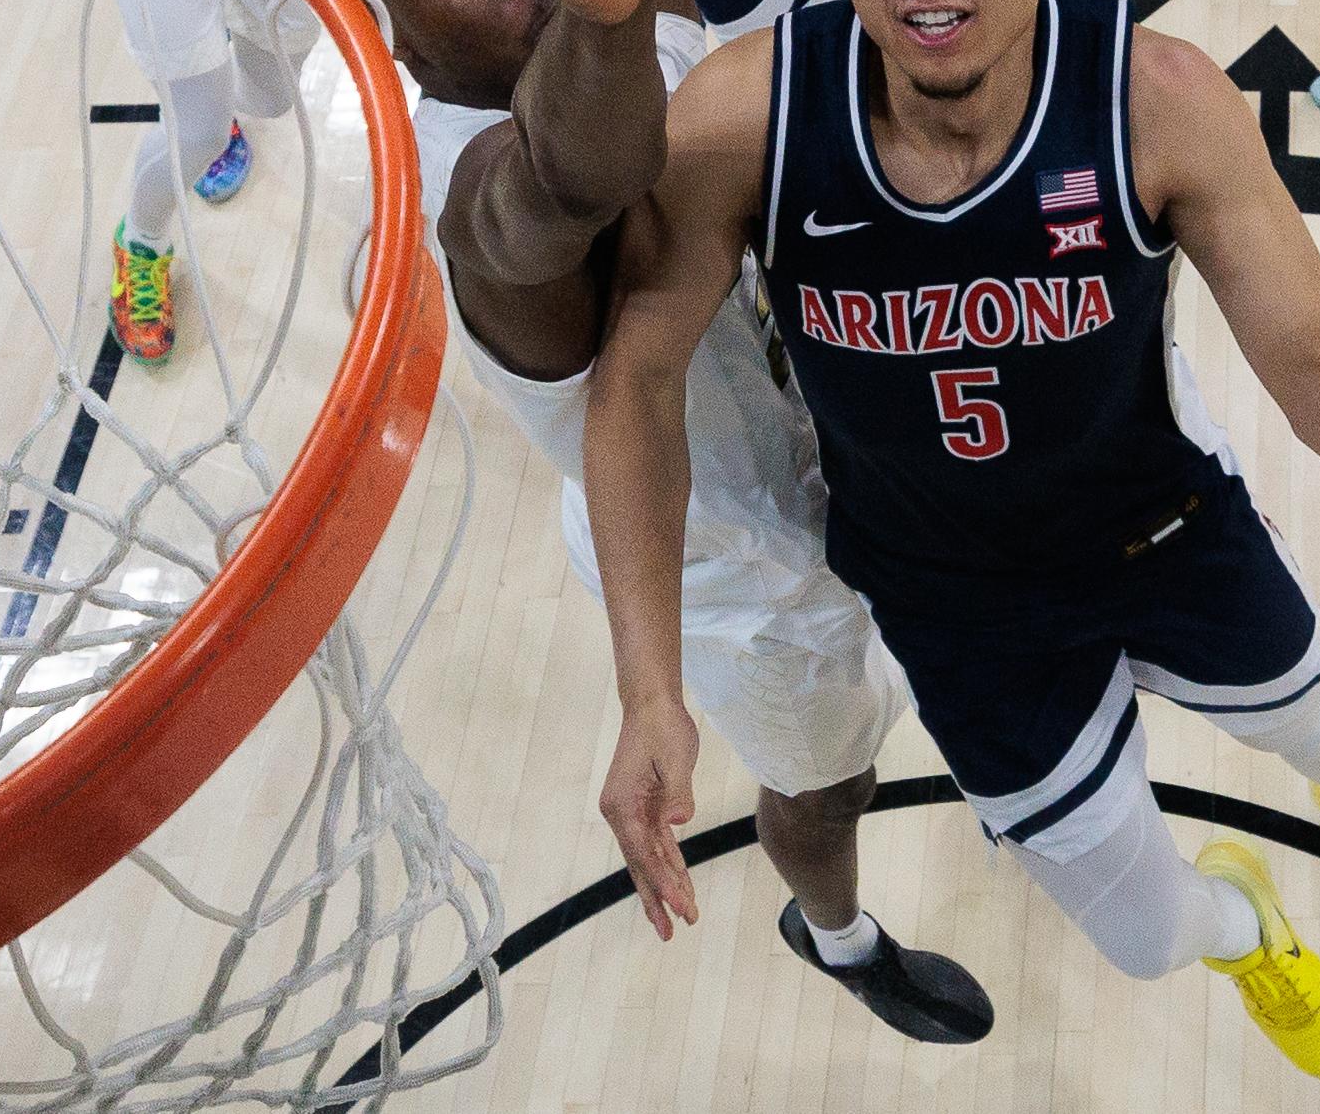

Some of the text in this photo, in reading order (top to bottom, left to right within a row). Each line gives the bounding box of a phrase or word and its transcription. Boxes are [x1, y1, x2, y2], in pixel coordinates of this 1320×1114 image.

[1050, 218, 1105, 257] XII
[798, 275, 1115, 354] ARIZONA
[929, 367, 1010, 461] 5
